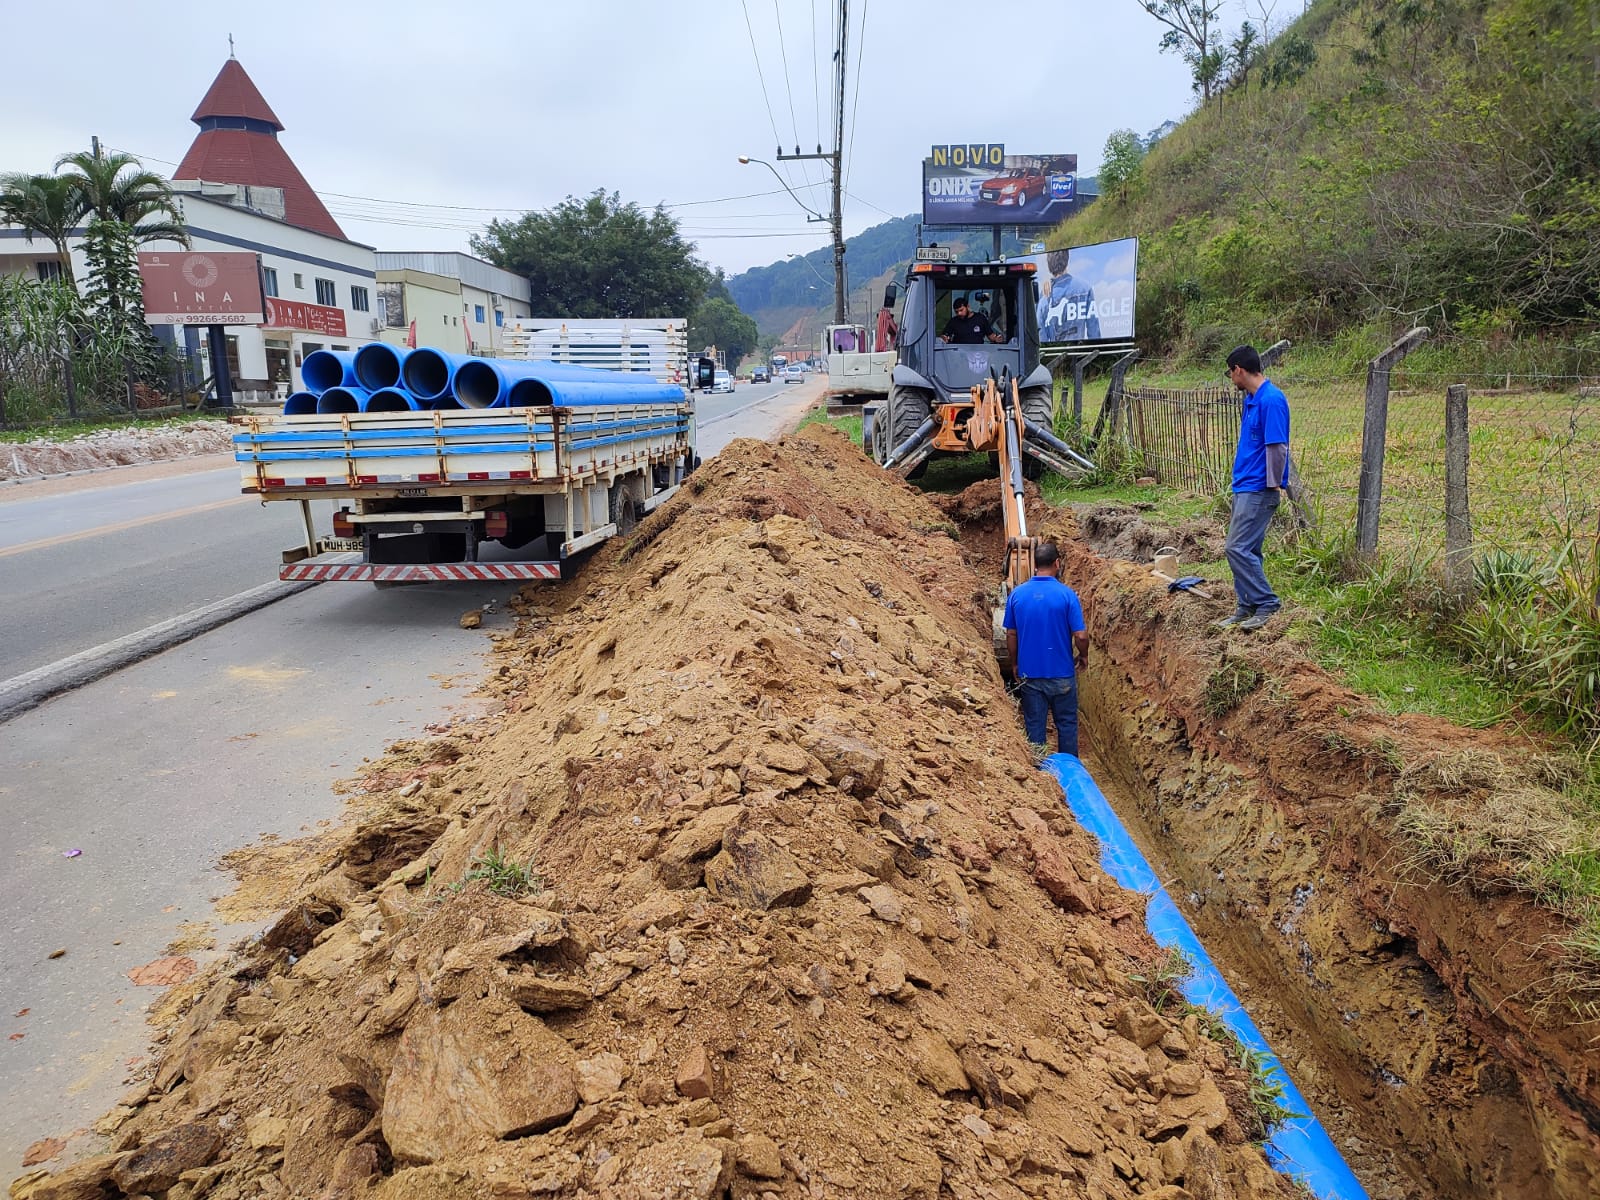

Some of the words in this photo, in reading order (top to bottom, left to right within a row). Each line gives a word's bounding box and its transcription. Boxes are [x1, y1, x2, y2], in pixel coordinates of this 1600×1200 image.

[933, 147, 1002, 166] NOVO
[928, 177, 973, 196] ONIX
[173, 291, 233, 303] INA
[1066, 297, 1131, 321] BEAGLE
[186, 315, 246, 323] 99266-5682
